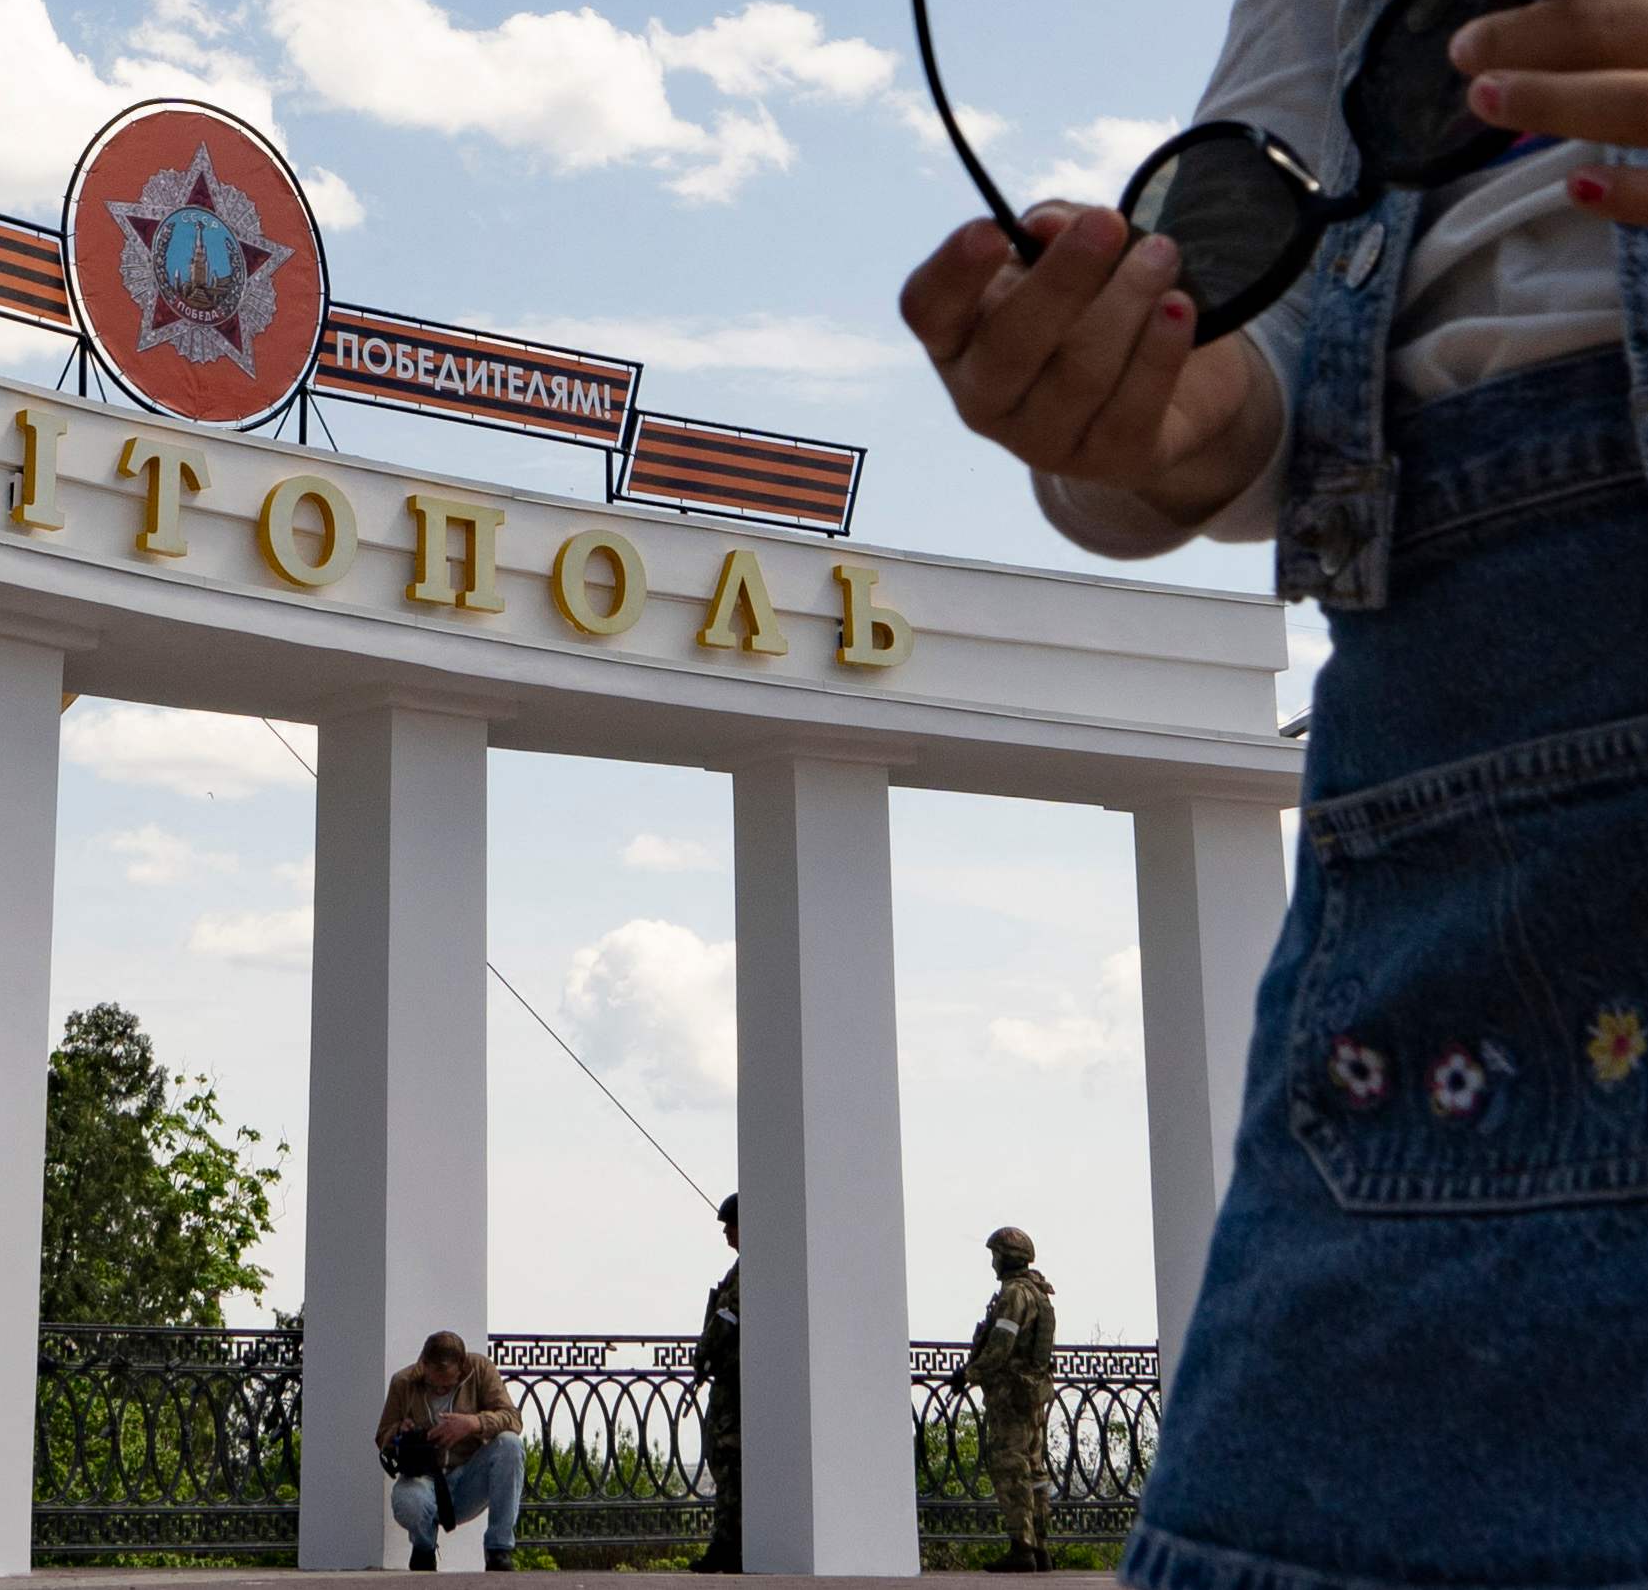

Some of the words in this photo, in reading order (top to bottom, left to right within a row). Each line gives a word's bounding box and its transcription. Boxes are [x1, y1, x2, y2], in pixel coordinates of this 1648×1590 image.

[181, 212, 219, 229] СССР
[177, 301, 219, 322] ПОБЕДА
[335, 330, 613, 422] ПОБЕДИТЕЛЯМ!
